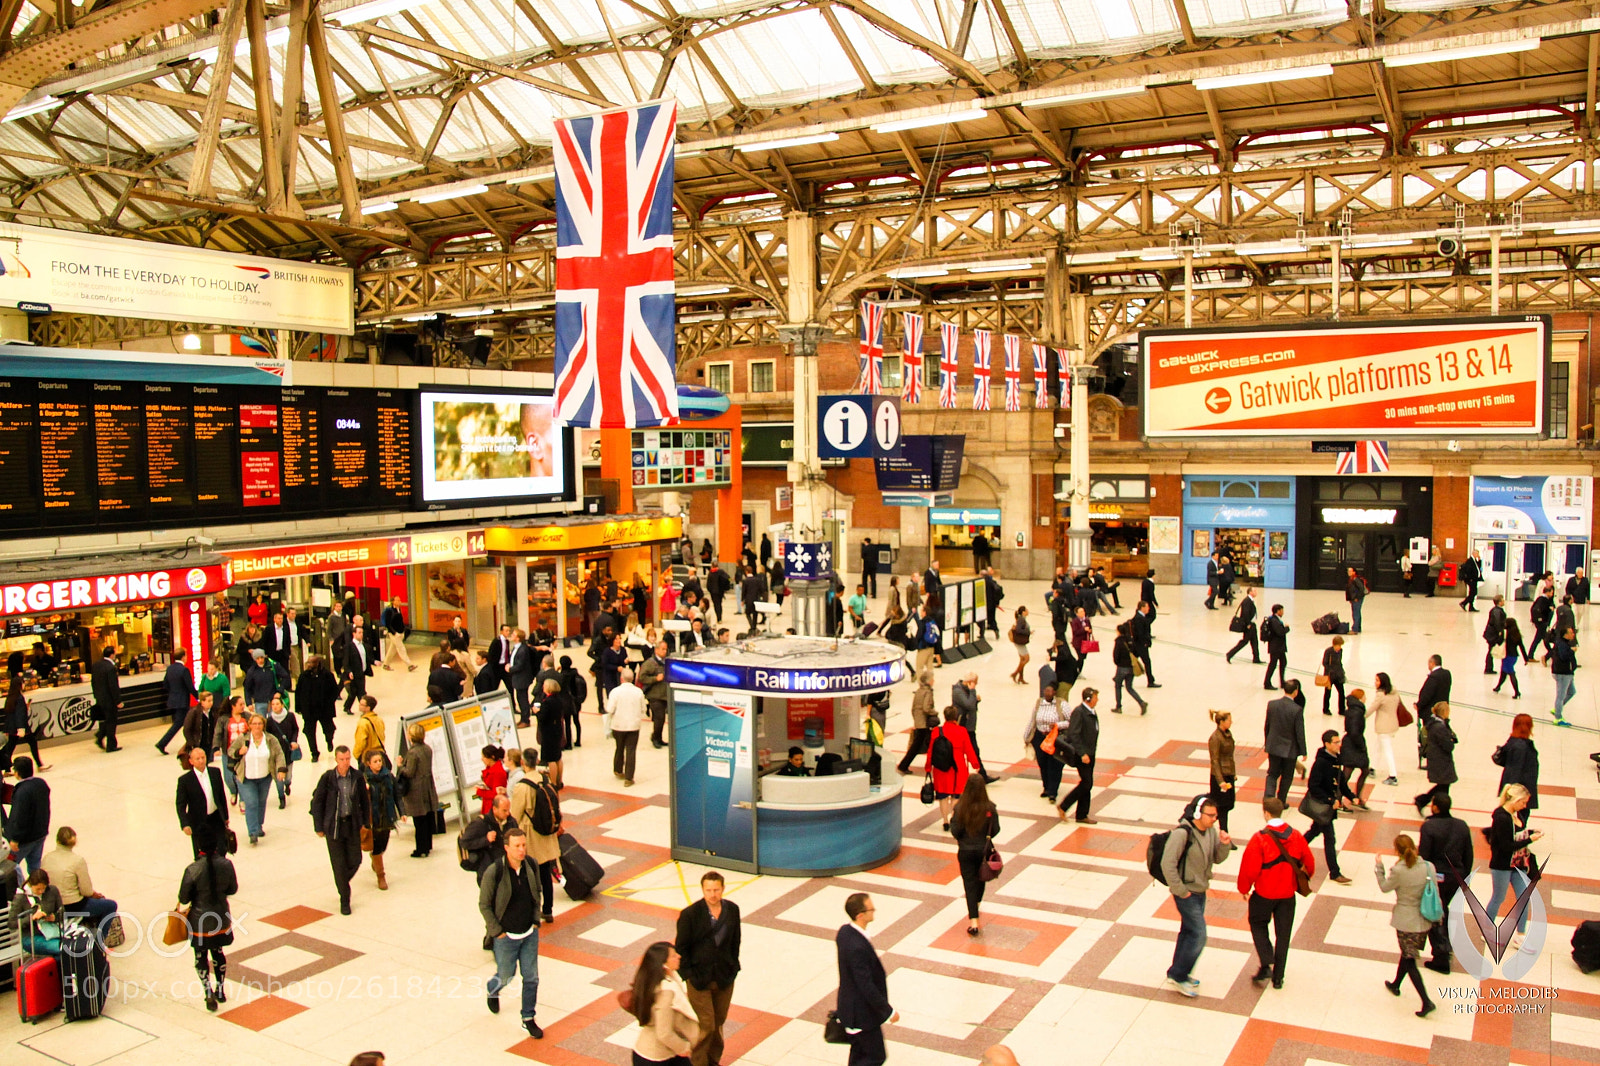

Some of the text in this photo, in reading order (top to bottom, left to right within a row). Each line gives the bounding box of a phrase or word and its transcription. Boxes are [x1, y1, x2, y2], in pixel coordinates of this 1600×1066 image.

[51, 260, 261, 294] FROM THE EVERYDAY TO HOLIDAY.
[274, 271, 344, 288] BRITISH AIRWAYS
[1239, 342, 1514, 410] Gatwick platforms 13 & 14
[38, 382, 68, 391] Departures
[94, 383, 122, 392] Departures
[145, 385, 172, 393] Departures
[193, 386, 218, 394] Departures
[1384, 393, 1516, 419] 30 mins non-stop every 15 mins
[1476, 485, 1500, 494] Passport
[1097, 504, 1123, 514] CASA
[391, 541, 449, 560] 13 Tickets
[470, 534, 486, 552] 14
[97, 571, 170, 604] KING
[755, 668, 887, 690] Rail information
[61, 701, 92, 718] BURGER
[705, 736, 734, 748] Victoria
[705, 747, 734, 759] Station
